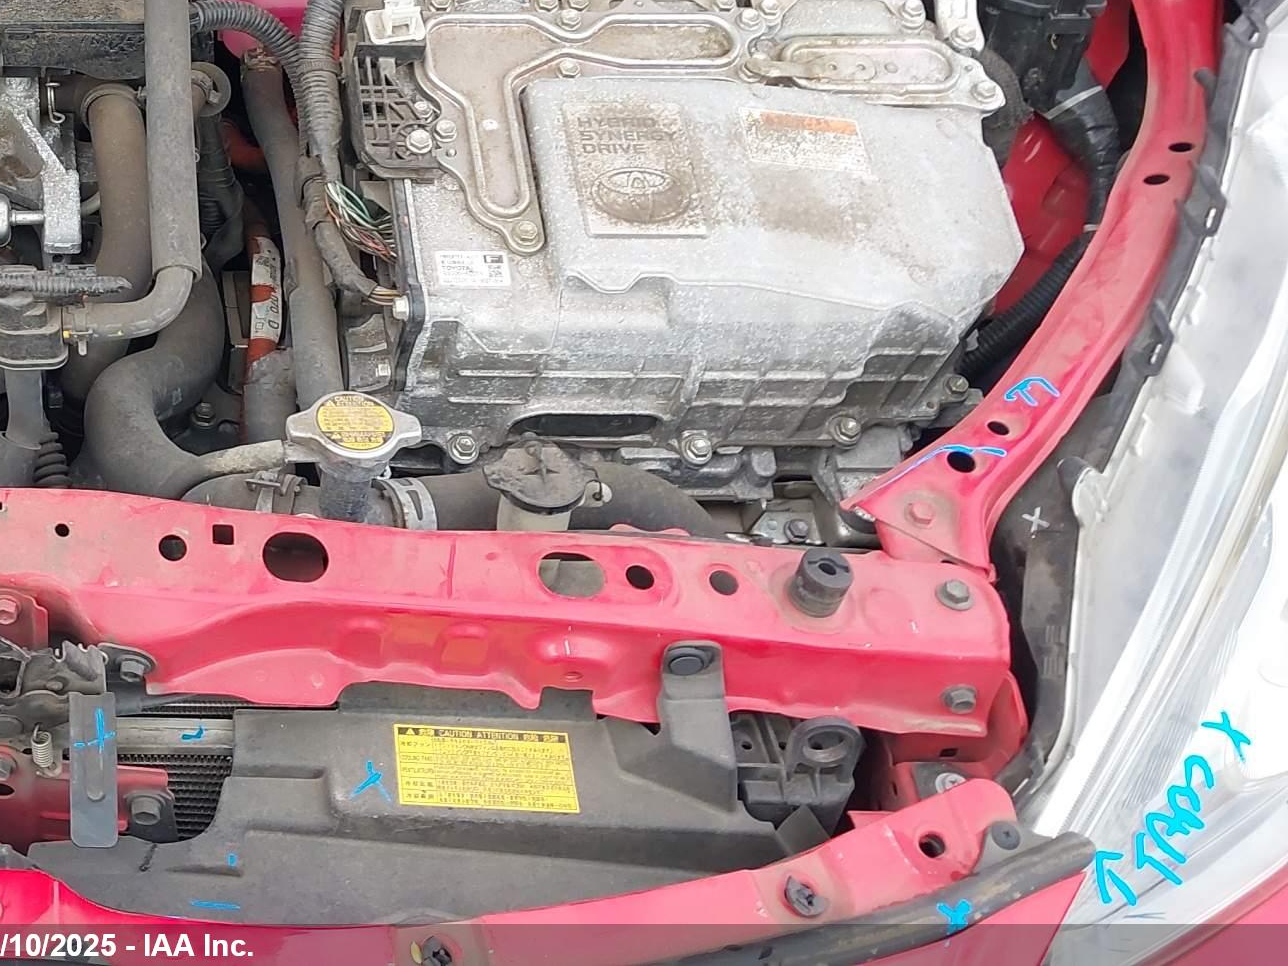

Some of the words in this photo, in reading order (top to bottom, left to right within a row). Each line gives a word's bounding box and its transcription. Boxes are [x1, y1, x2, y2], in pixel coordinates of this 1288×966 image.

[578, 117, 656, 128] HYBRID
[579, 130, 677, 141] SYNERGY
[583, 143, 646, 154] DRIVE
[439, 729, 473, 738] CAUTION
[476, 730, 519, 740] ATTENTION
